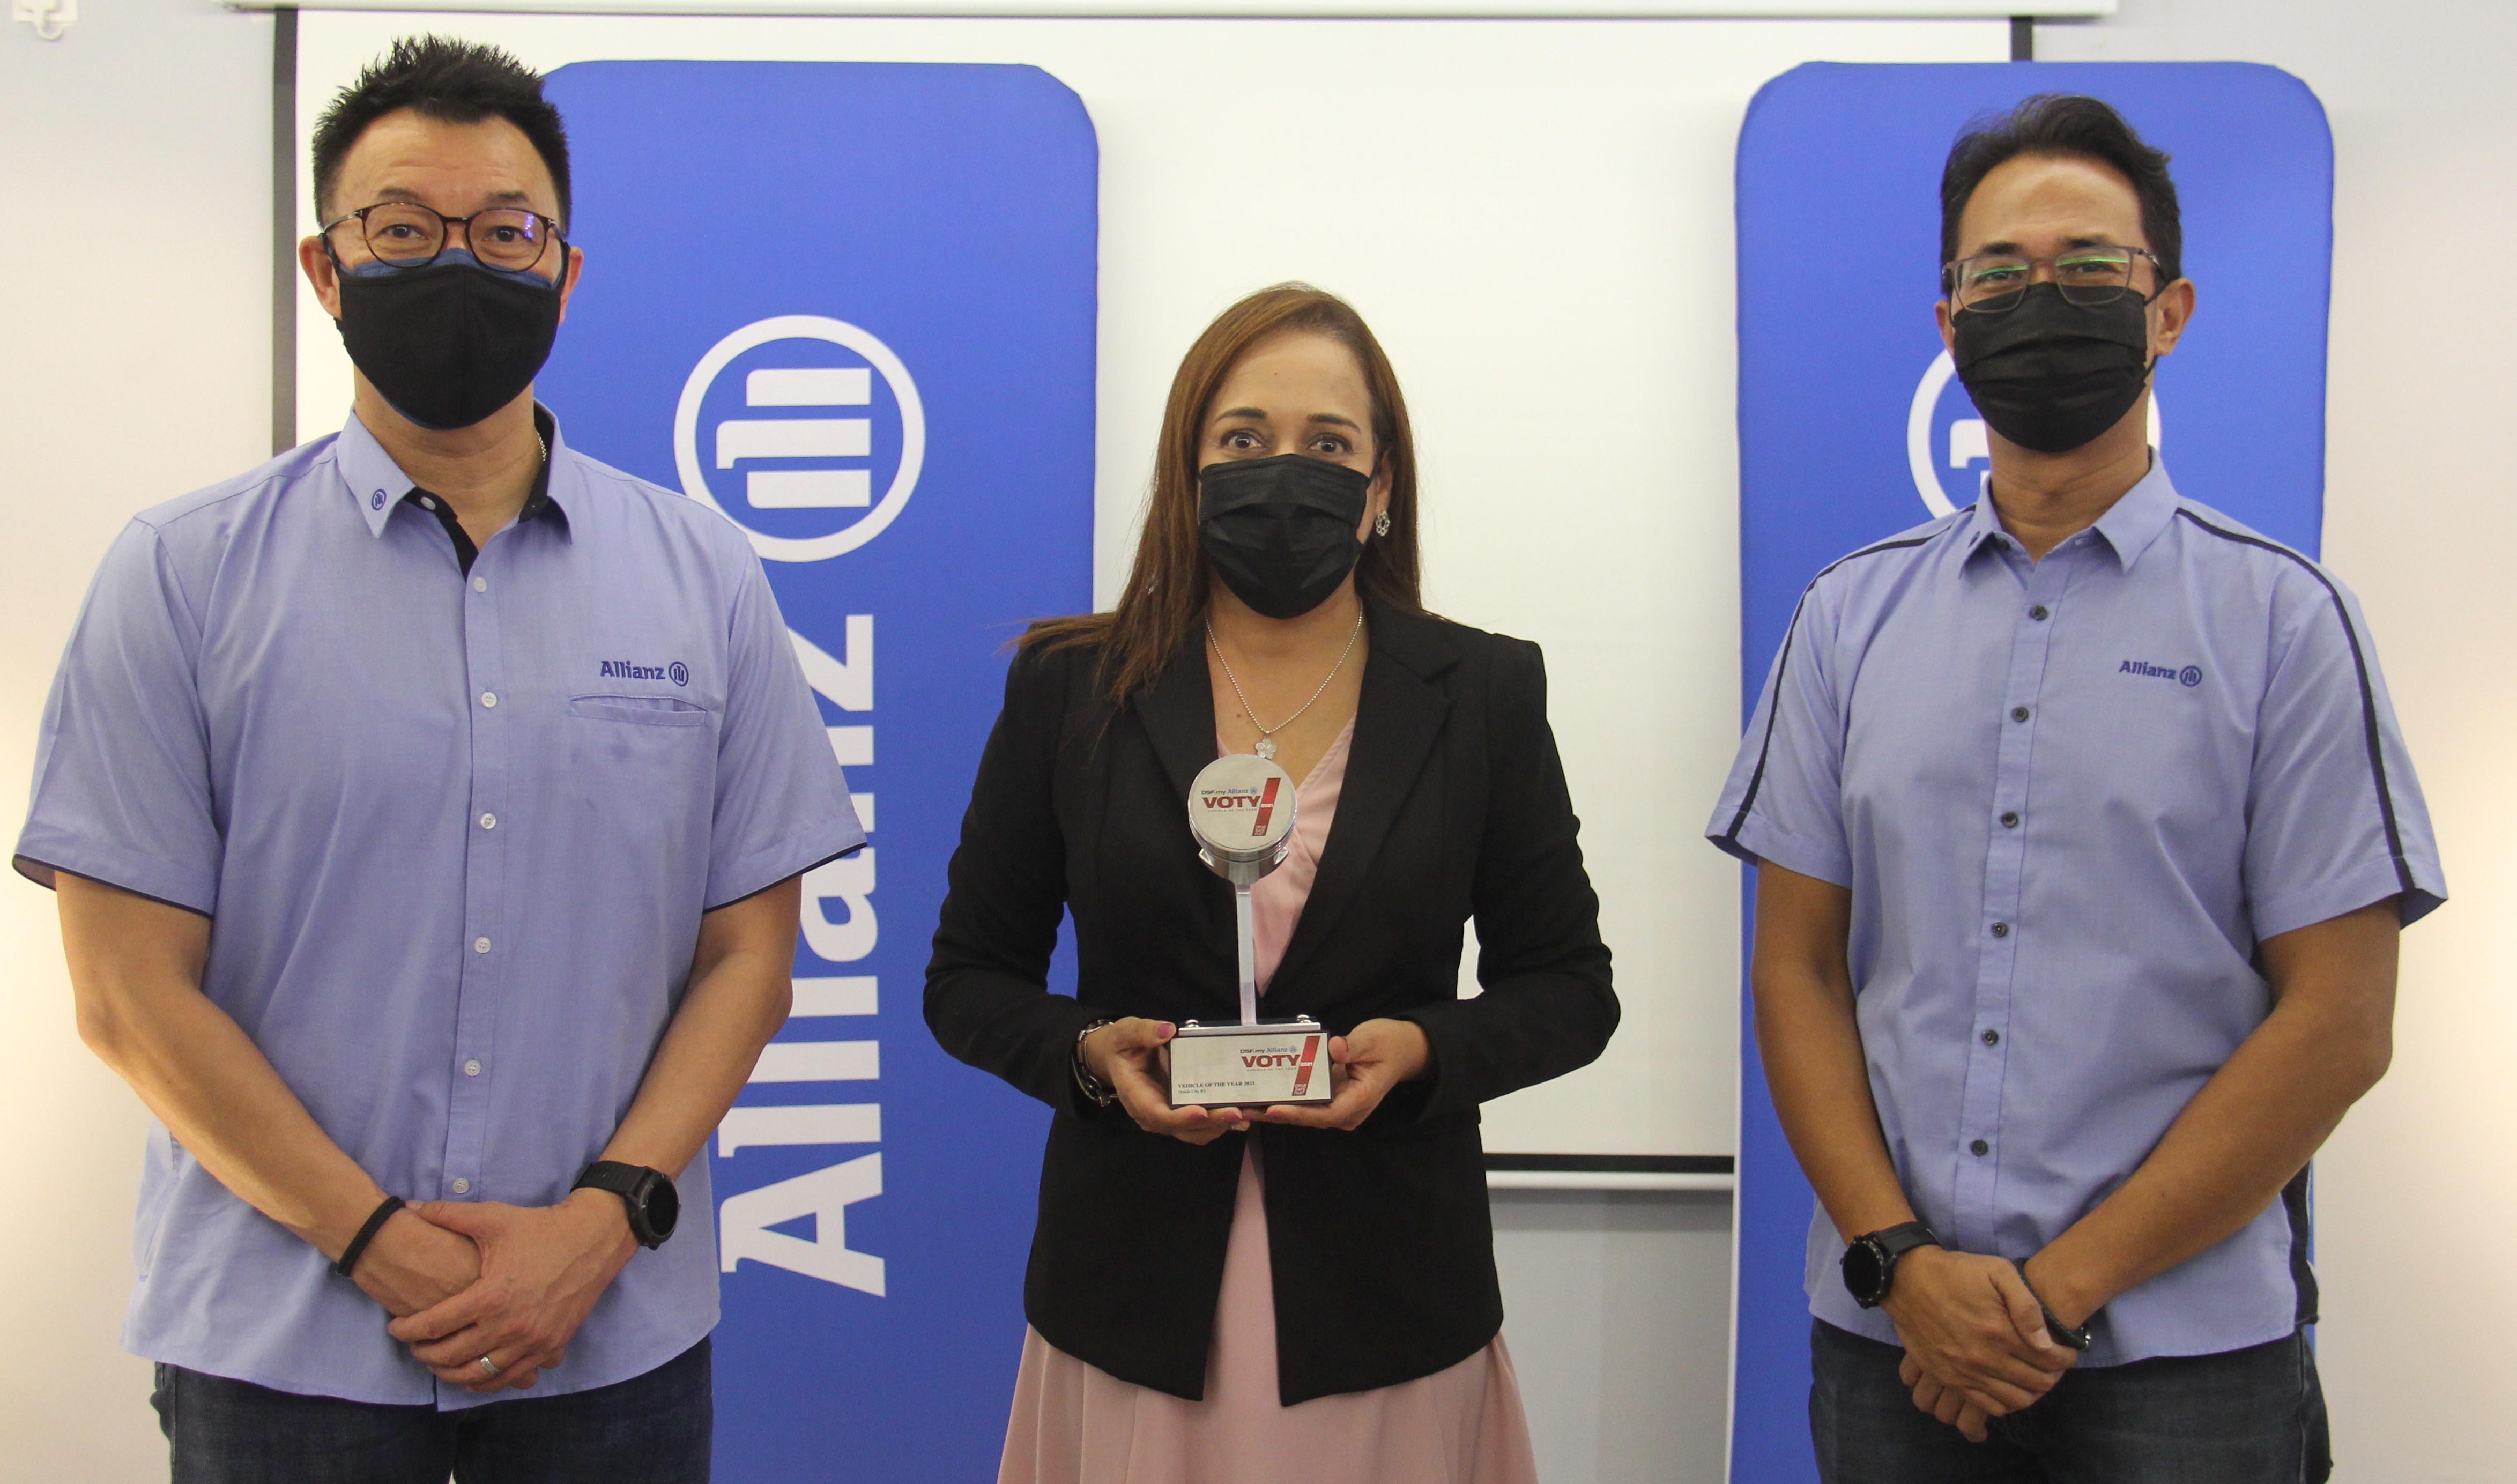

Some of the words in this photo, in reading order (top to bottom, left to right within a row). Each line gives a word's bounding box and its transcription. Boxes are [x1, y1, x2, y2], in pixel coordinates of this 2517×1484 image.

[600, 660, 666, 680] Allianz
[2119, 660, 2177, 680] Allianz
[1202, 796, 1261, 808] VOTY
[1241, 1054, 1301, 1067] VOTY
